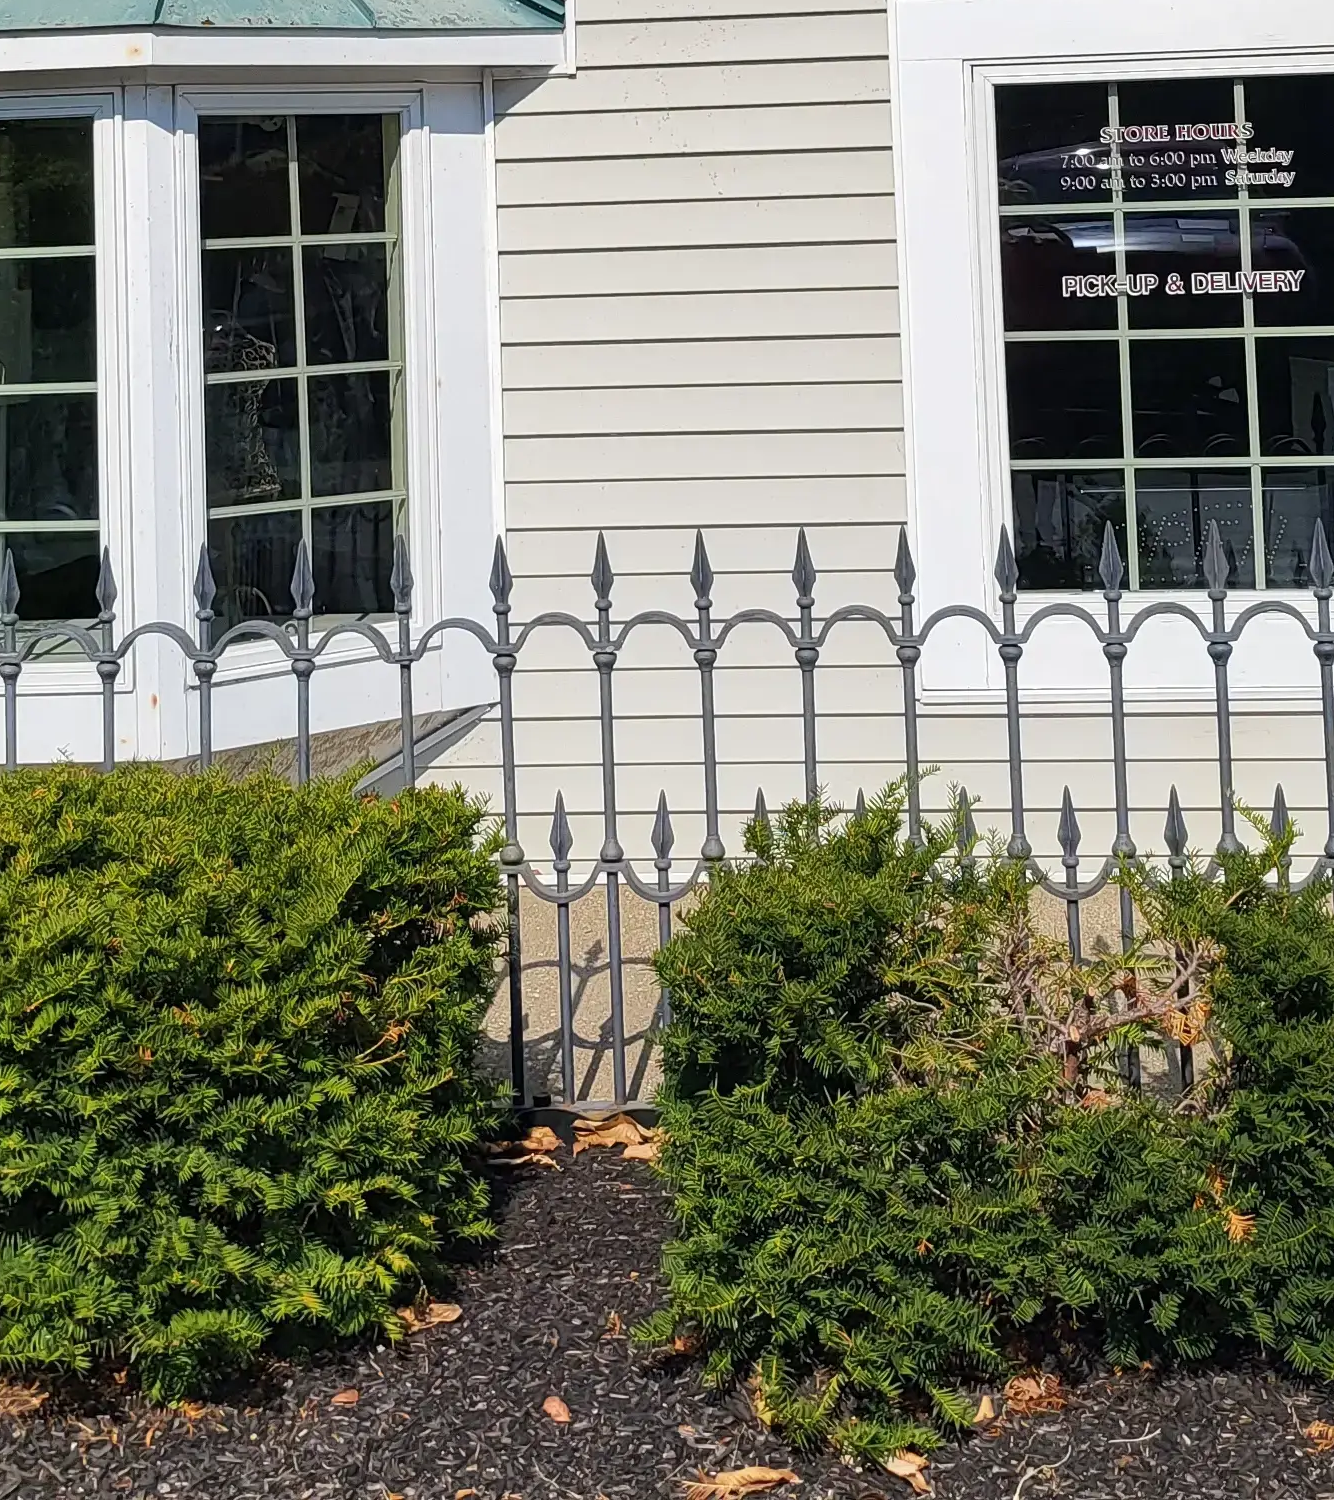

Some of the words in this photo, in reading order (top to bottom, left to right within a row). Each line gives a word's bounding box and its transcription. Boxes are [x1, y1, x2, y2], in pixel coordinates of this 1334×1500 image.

[1099, 125, 1171, 143] STORE
[1175, 122, 1255, 141] HOURS
[1060, 154, 1095, 169] 7:00
[1129, 153, 1145, 167] to
[1149, 151, 1185, 166] 6:00
[1190, 153, 1217, 168] pm
[1220, 147, 1294, 166] Weekday
[1060, 176, 1096, 190] 9:00
[1130, 174, 1146, 188] to
[1150, 173, 1186, 187] 3:00
[1191, 175, 1218, 190] pm
[1225, 168, 1296, 187] Saturday
[1062, 273, 1158, 297] PICK-UP
[1165, 273, 1185, 295] &
[1191, 270, 1305, 294] DELIVERY
